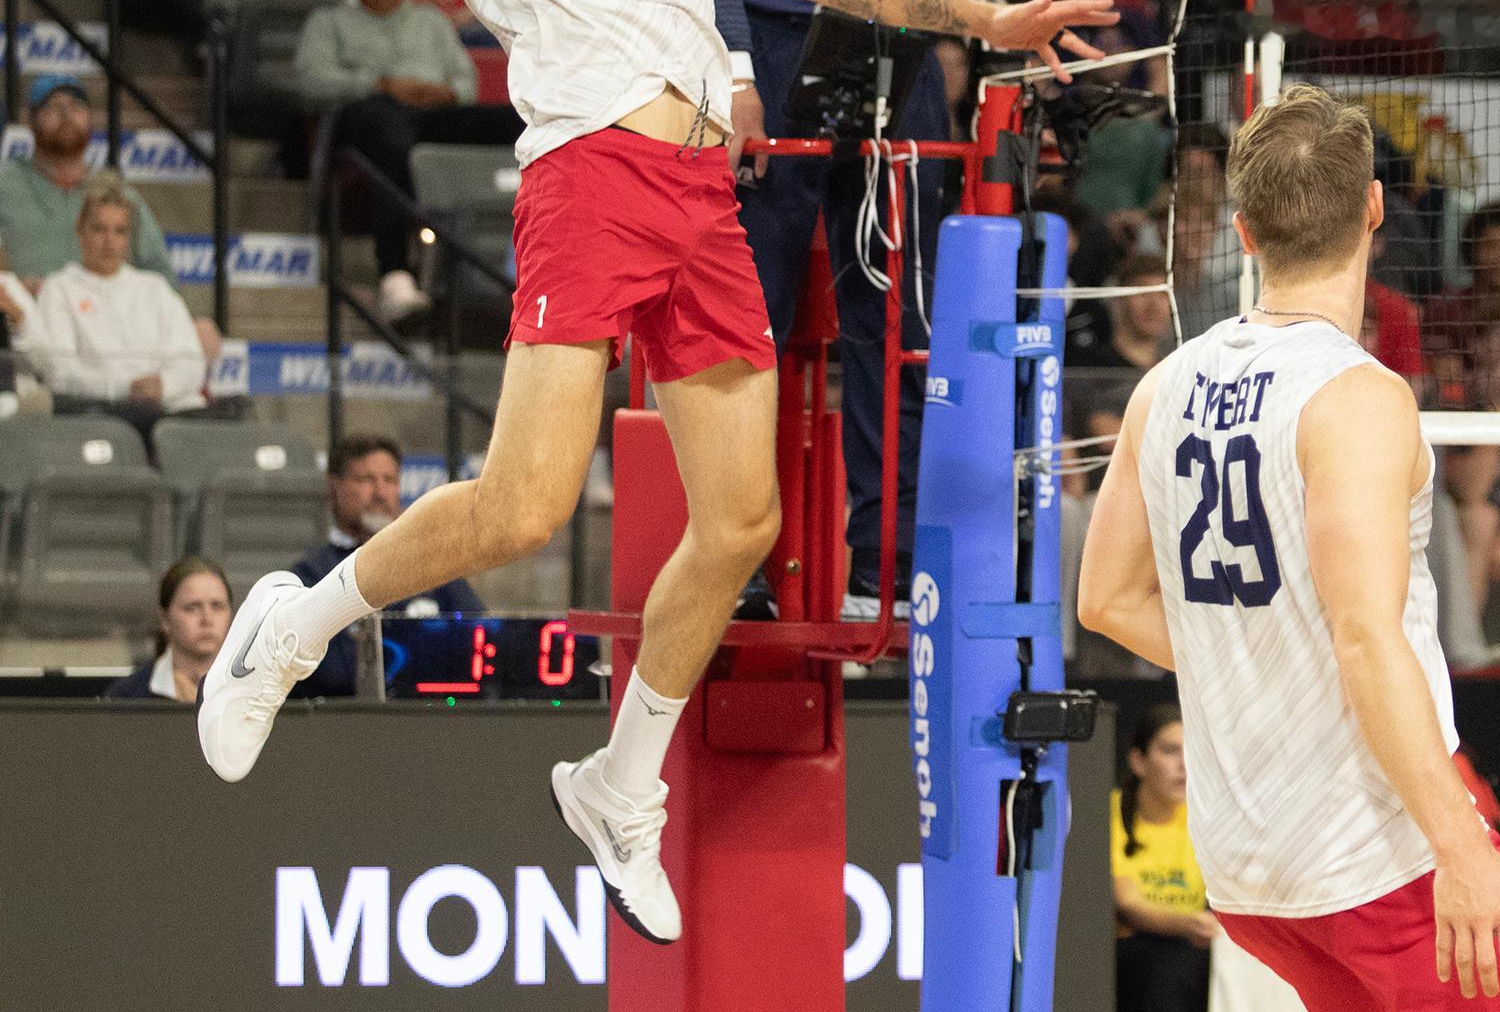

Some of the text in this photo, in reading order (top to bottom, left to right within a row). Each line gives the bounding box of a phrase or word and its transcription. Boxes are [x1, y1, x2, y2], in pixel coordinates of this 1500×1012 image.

[536, 294, 548, 329] 1
[1016, 326, 1052, 344] FIVB
[1175, 432, 1283, 608] 29
[911, 632, 938, 839] Senoh
